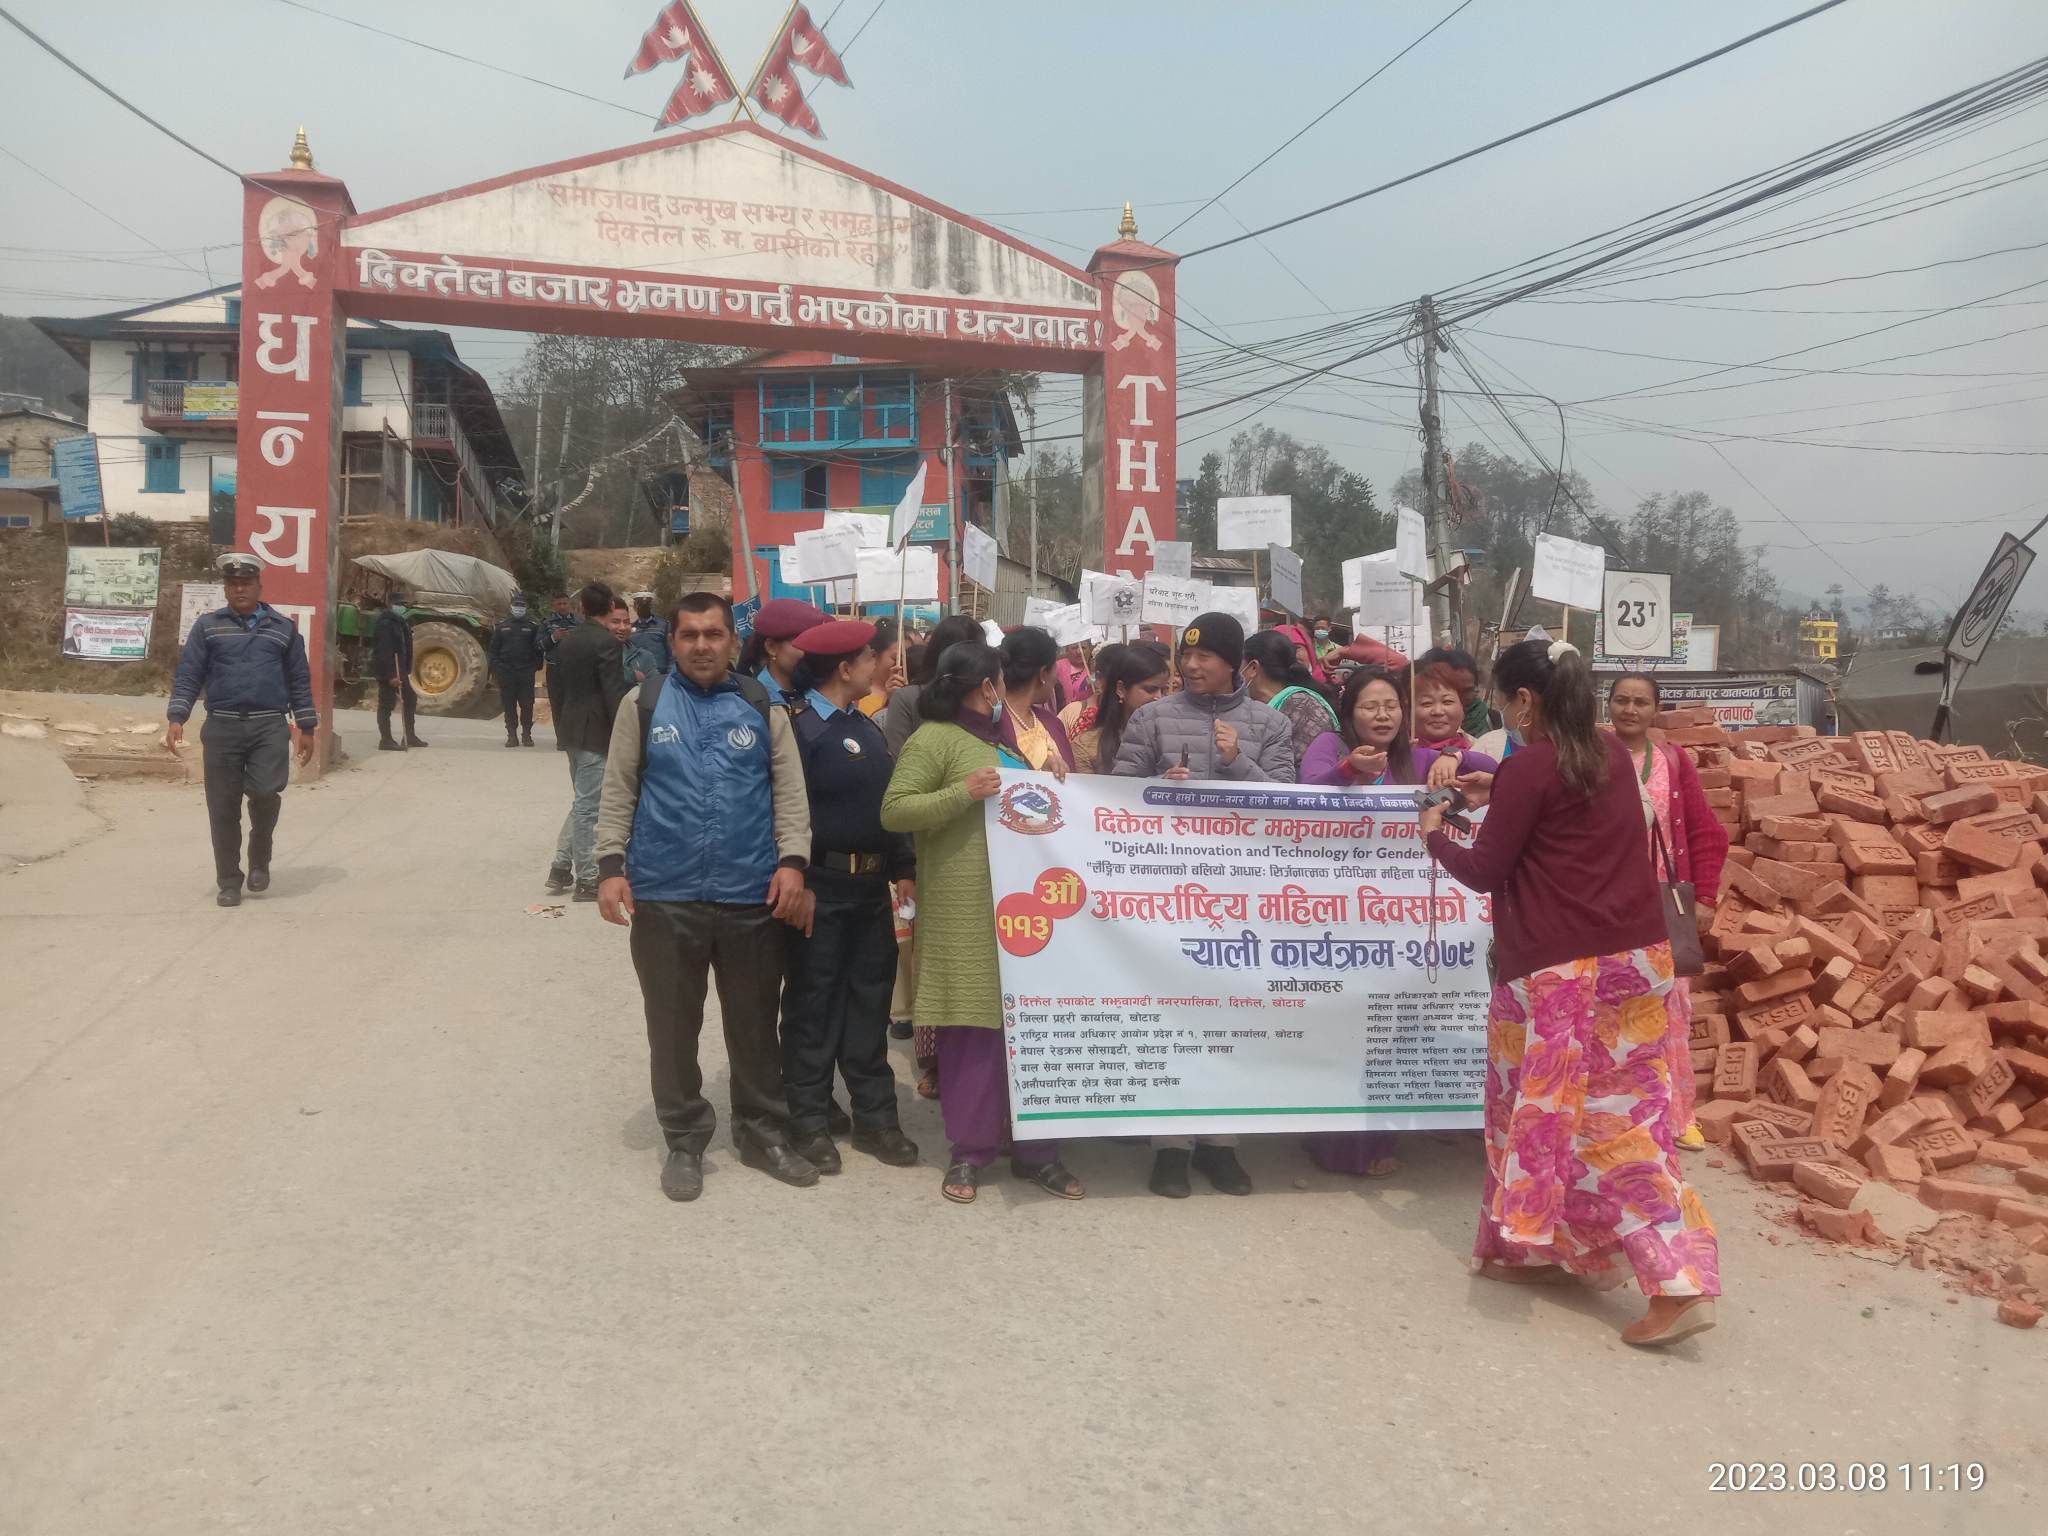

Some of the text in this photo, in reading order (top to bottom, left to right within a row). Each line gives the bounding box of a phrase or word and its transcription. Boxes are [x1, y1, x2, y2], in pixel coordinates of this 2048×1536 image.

[595, 211, 686, 249] दिक्तेल
[751, 228, 840, 259] बासीको
[356, 248, 505, 297] दिक्तेल
[506, 269, 615, 313] बजार
[616, 280, 722, 316] भ्रमण
[724, 284, 794, 328] गर्नु
[799, 293, 952, 332] भएकोमा
[1720, 688, 1761, 699] यातायात
[1777, 685, 1794, 698] लि.
[1863, 738, 1892, 768] BSK
[1895, 737, 1921, 766] BSK
[1961, 765, 2006, 779] BSK
[1175, 792, 1196, 803] हाम्रो
[1248, 793, 1269, 806] हाम्रो
[1297, 797, 1316, 806] नगर
[1331, 798, 1341, 807] छ
[1171, 842, 1242, 857] Innovation
[1246, 845, 1270, 858] and
[1272, 845, 1349, 861] Technology
[1353, 847, 1373, 859] for
[1376, 847, 1425, 860] Gender
[1130, 863, 1187, 876] समानताको
[1191, 863, 1226, 877] बलियो
[1334, 865, 1377, 879] प्रविधिमा
[1381, 866, 1415, 880] महिला
[1257, 883, 1349, 926] महिला
[1357, 885, 1467, 926] दिवसको
[998, 914, 1050, 941] ११३
[1367, 992, 1390, 1000] मानव
[1394, 991, 1438, 1000] अधिकारको
[1464, 989, 1490, 999] महिला
[1271, 997, 1306, 1008] खोटाङ
[1367, 1002, 1393, 1011] महिला
[1421, 1002, 1454, 1011] अधिकार
[1019, 1012, 1048, 1024] जिल्ला
[1053, 1012, 1076, 1024] प्रहरी
[1128, 1012, 1161, 1023] खोटाङ
[1366, 1013, 1393, 1023] महिला
[1751, 1004, 1802, 1027] BSK
[1053, 1031, 1076, 1040] मानव
[1080, 1029, 1117, 1040] अधिकार
[1121, 1029, 1149, 1039] आयोग
[1153, 1029, 1173, 1040] प्रदेश
[1202, 1029, 1227, 1039] शाखा
[1274, 1029, 1304, 1039] खोटाङ
[1366, 1024, 1392, 1034] महिला
[1440, 1024, 1463, 1032] नेपाल
[1366, 1036, 1388, 1045] नेपाल
[1392, 1035, 1417, 1044] महिला
[1020, 1046, 1045, 1056] नेपाल
[1050, 1045, 1083, 1056] रेडक्रस
[1136, 1043, 1169, 1054] खोटाङ
[1173, 1043, 1202, 1055] जिल्ला
[1207, 1045, 1235, 1054] शाखा
[1366, 1047, 1392, 1056] अखिल
[1396, 1047, 1418, 1055] नेपाल
[1422, 1046, 1448, 1055] महिला
[1044, 1061, 1062, 1073] सेवा
[1066, 1062, 1094, 1073] समाज
[1134, 1060, 1167, 1071] खोटाङ
[1366, 1058, 1392, 1067] अखिल
[1396, 1058, 1418, 1066] नेपाल
[1423, 1057, 1449, 1066] महिला
[1401, 1068, 1459, 1078] महिला विकास
[1021, 1076, 1078, 1089] अनौपचारिक
[1081, 1077, 1099, 1088] क्षेत्र
[1104, 1076, 1123, 1088] सेवा
[1127, 1076, 1147, 1087] केन्द्र
[1366, 1079, 1462, 1090] कालिका महिला विकास
[1022, 1094, 1050, 1106] अखिल
[1054, 1094, 1080, 1105] नेपाल
[1084, 1092, 1115, 1104] महिला
[1418, 1091, 1443, 1100] महिला
[1764, 1145, 1820, 1160] BSK
